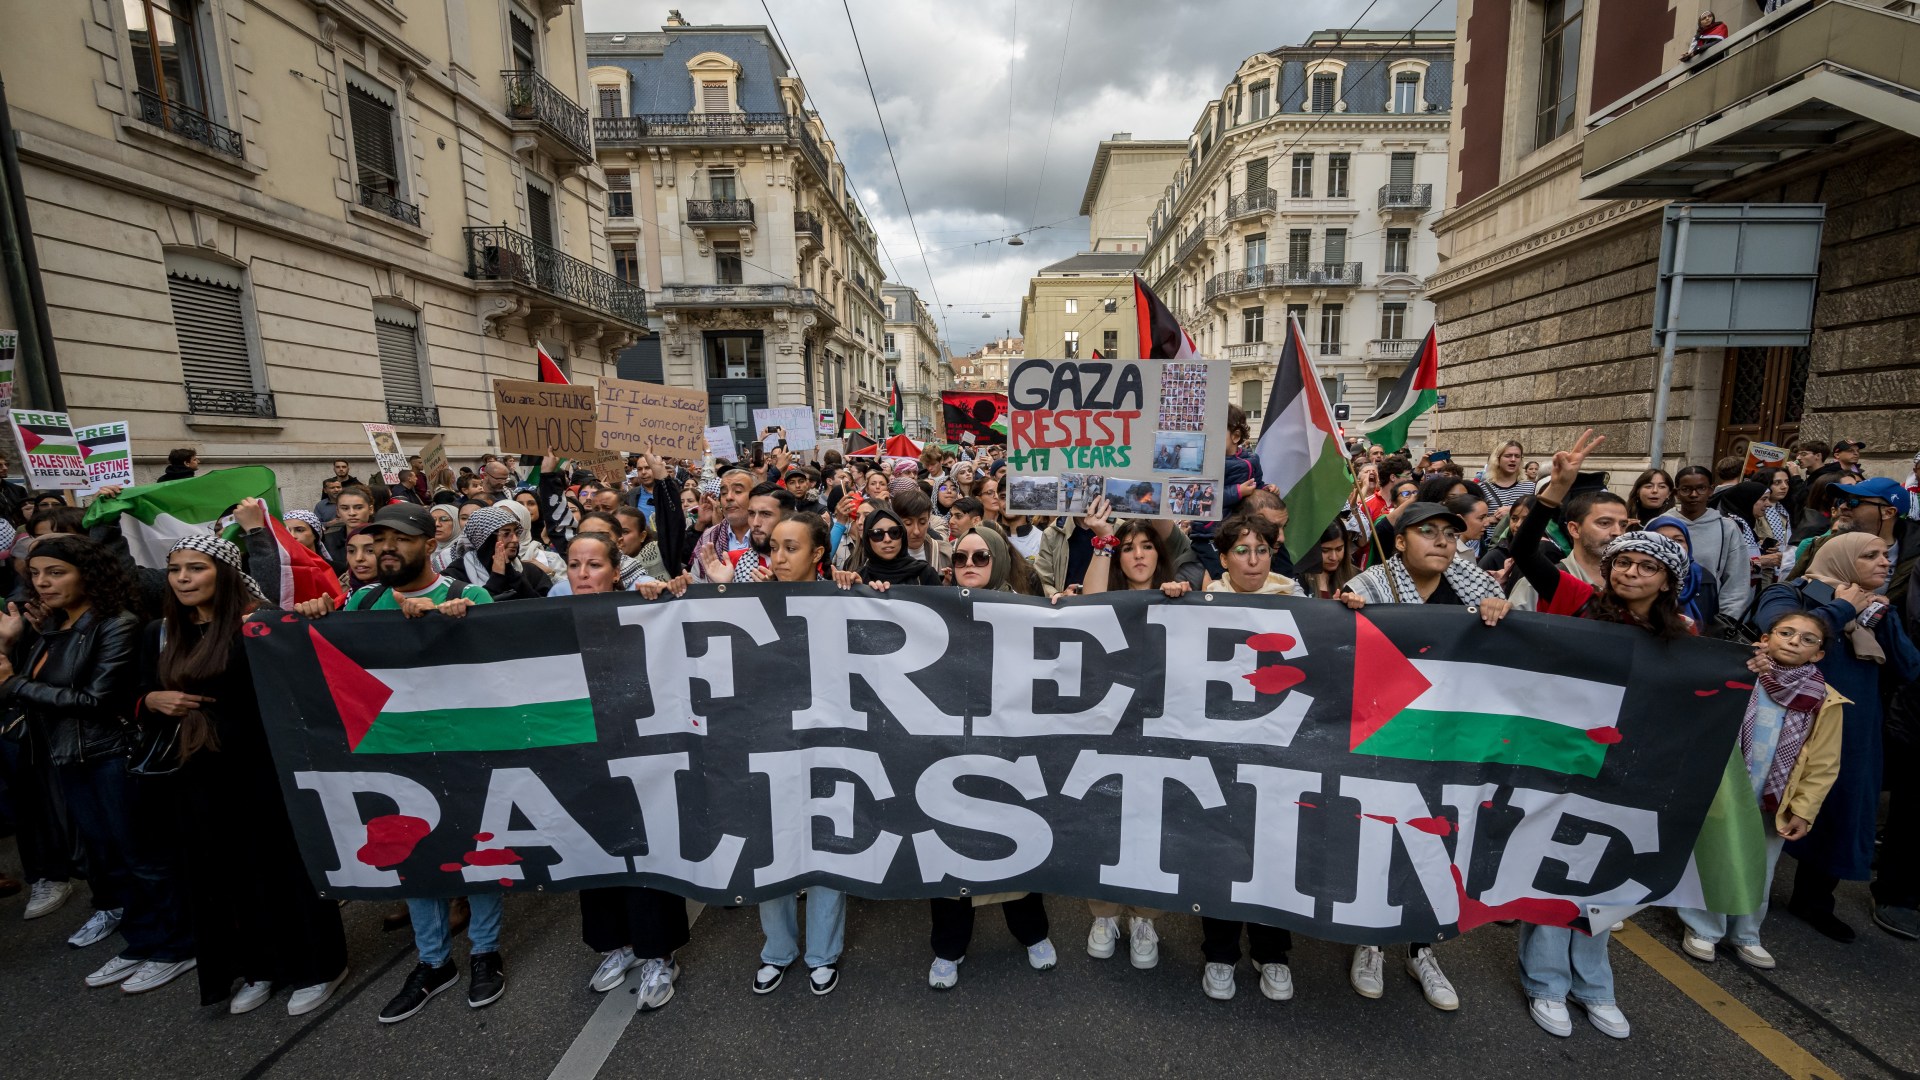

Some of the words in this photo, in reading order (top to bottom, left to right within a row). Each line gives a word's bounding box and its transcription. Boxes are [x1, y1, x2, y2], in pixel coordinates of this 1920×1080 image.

[1008, 359, 1144, 411] GAZA
[519, 396, 535, 405] are
[628, 390, 640, 404] I
[641, 394, 668, 408] don't
[670, 398, 706, 413] steal
[12, 412, 70, 427] FREE
[75, 424, 125, 440] FREE
[502, 414, 530, 449] MY
[1011, 409, 1142, 450] RESIST
[600, 430, 641, 449] gonna
[643, 434, 685, 449] steal
[29, 454, 84, 469] PALESTINE
[1008, 448, 1051, 472] +17
[1060, 445, 1133, 470] YEARS
[1754, 449, 1779, 459] INTIFADA
[34, 468, 60, 477] FREE
[62, 468, 87, 477] GAZA
[89, 458, 130, 476] LESTINE
[90, 475, 101, 483] EE
[103, 470, 130, 480] GAZA
[617, 596, 1314, 747] FREE
[294, 746, 1659, 930] PALESTINE
